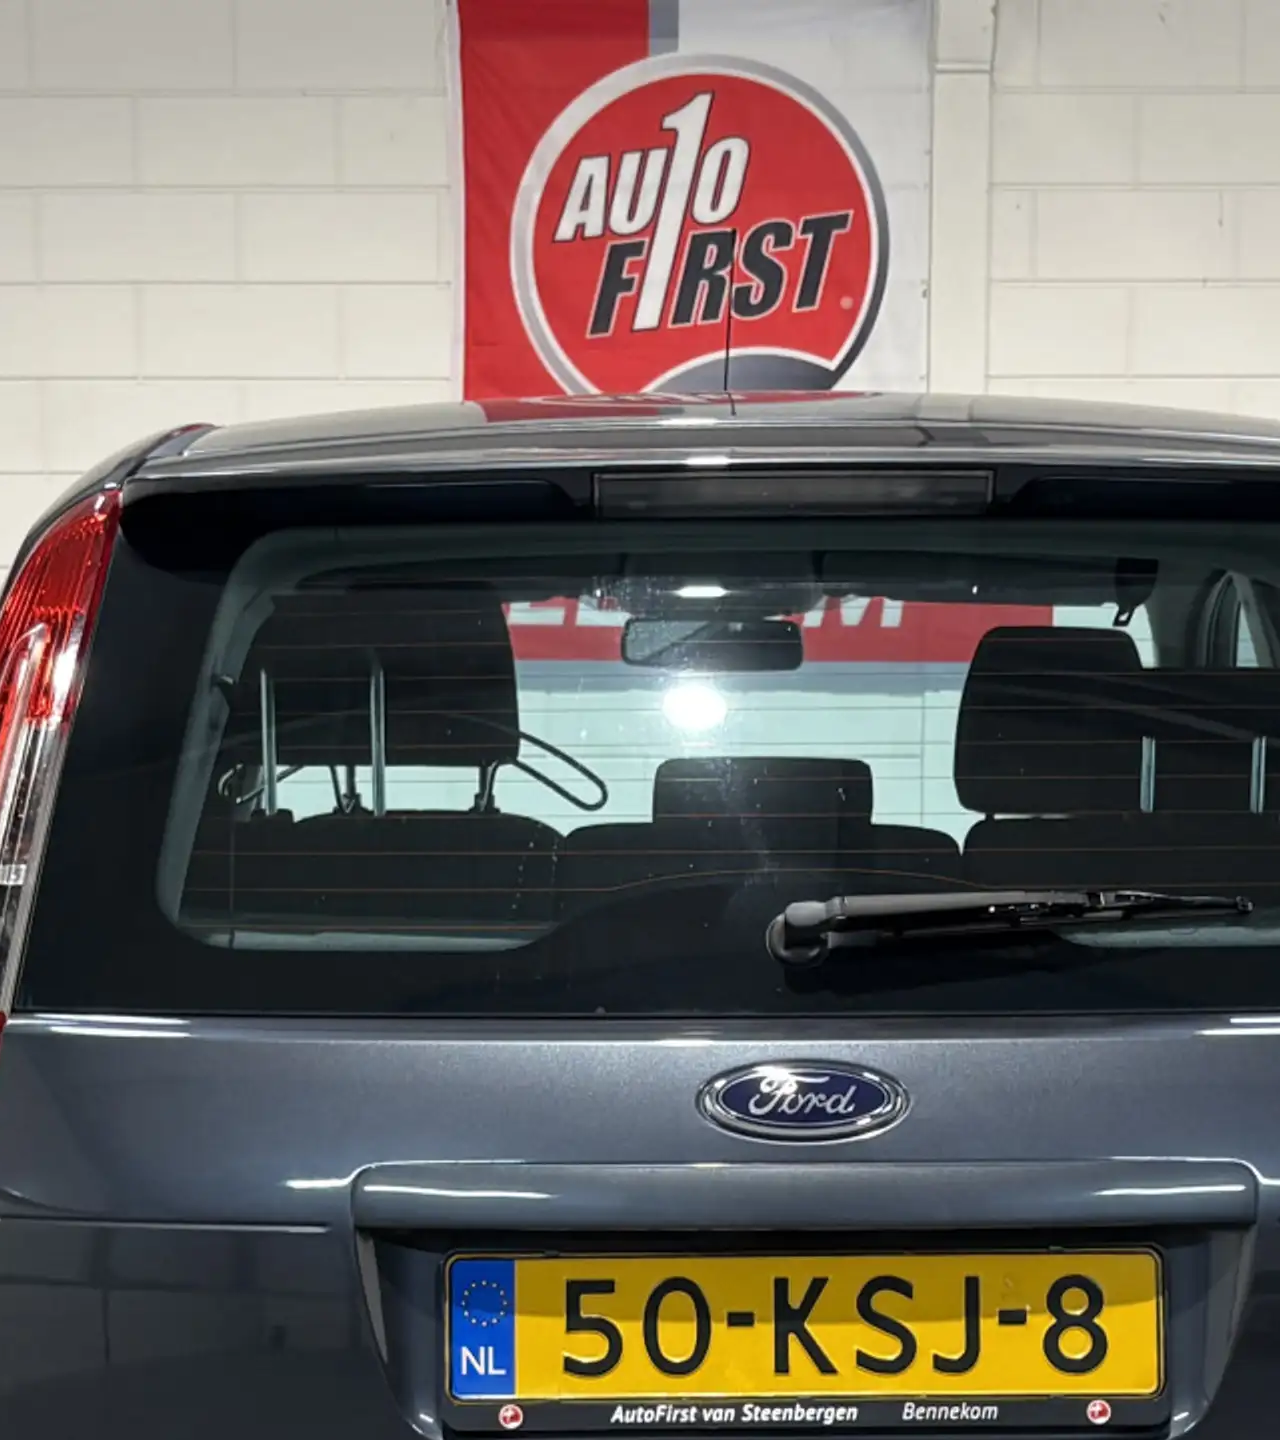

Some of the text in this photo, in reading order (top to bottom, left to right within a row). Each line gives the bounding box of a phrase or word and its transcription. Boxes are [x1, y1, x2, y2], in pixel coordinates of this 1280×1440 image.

[748, 1069, 857, 1116] Ford
[561, 1274, 1111, 1377] 50-KSJ-8
[460, 1346, 506, 1377] NL
[610, 1403, 858, 1425] AutoFirst van Steenbergen
[902, 1401, 999, 1421] Bennekom
